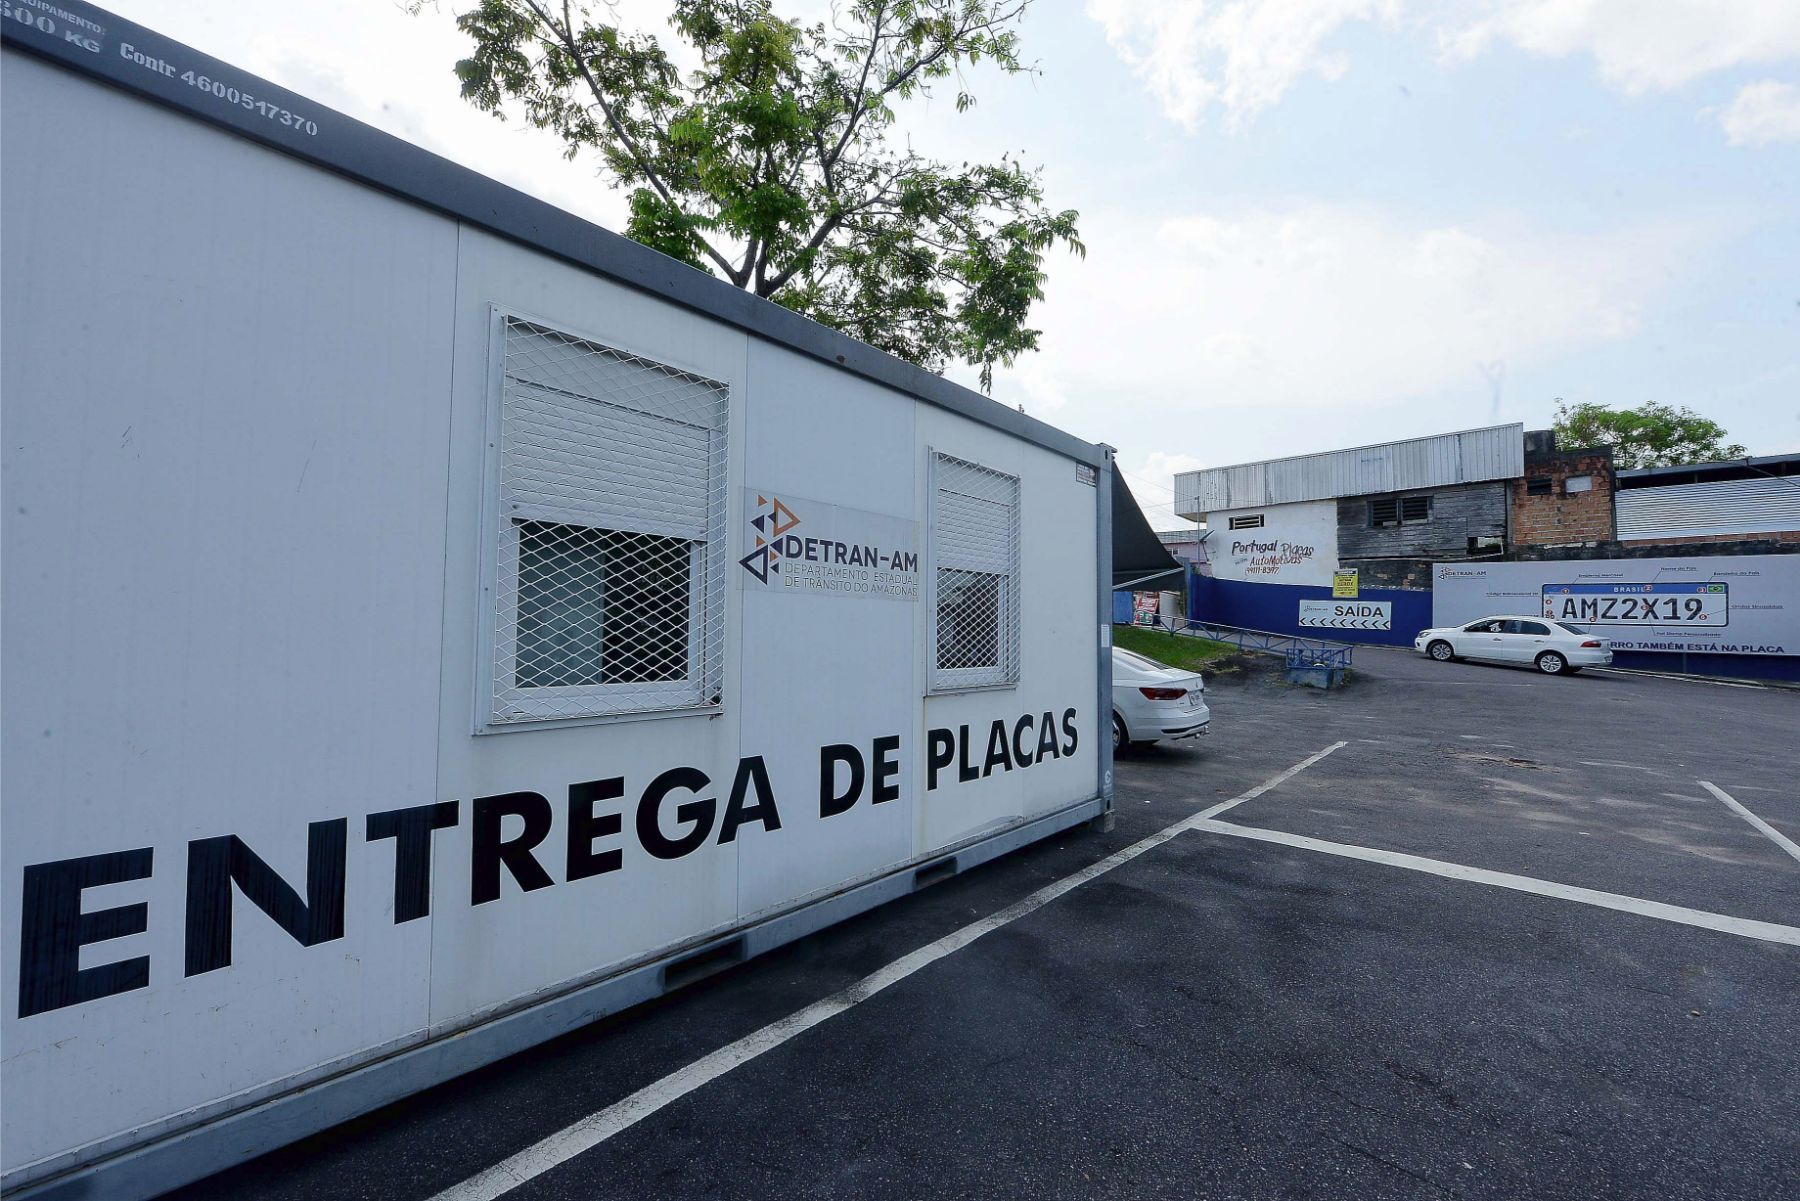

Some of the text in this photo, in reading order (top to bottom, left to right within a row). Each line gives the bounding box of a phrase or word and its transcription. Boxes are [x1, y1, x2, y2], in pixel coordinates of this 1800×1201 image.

[65, 30, 99, 53] KG
[181, 70, 318, 136] 4600517370
[785, 534, 918, 573] DETRAN-AM
[1232, 539, 1279, 556] Portugal
[785, 562, 917, 586] DEPARTAMENTO ESTADUAL
[785, 575, 918, 597] DE TRÂNSITO DO AMAZONAS
[1334, 603, 1384, 618] SAÍDA
[1561, 597, 1703, 621] AMZ2X19
[1609, 641, 1634, 649] RRO
[1636, 640, 1684, 651] TAMBÉM
[1687, 642, 1718, 652] ESTÁ
[1741, 645, 1785, 654] PLACA
[18, 707, 1079, 1019] ENTREGA DE PLACAS
